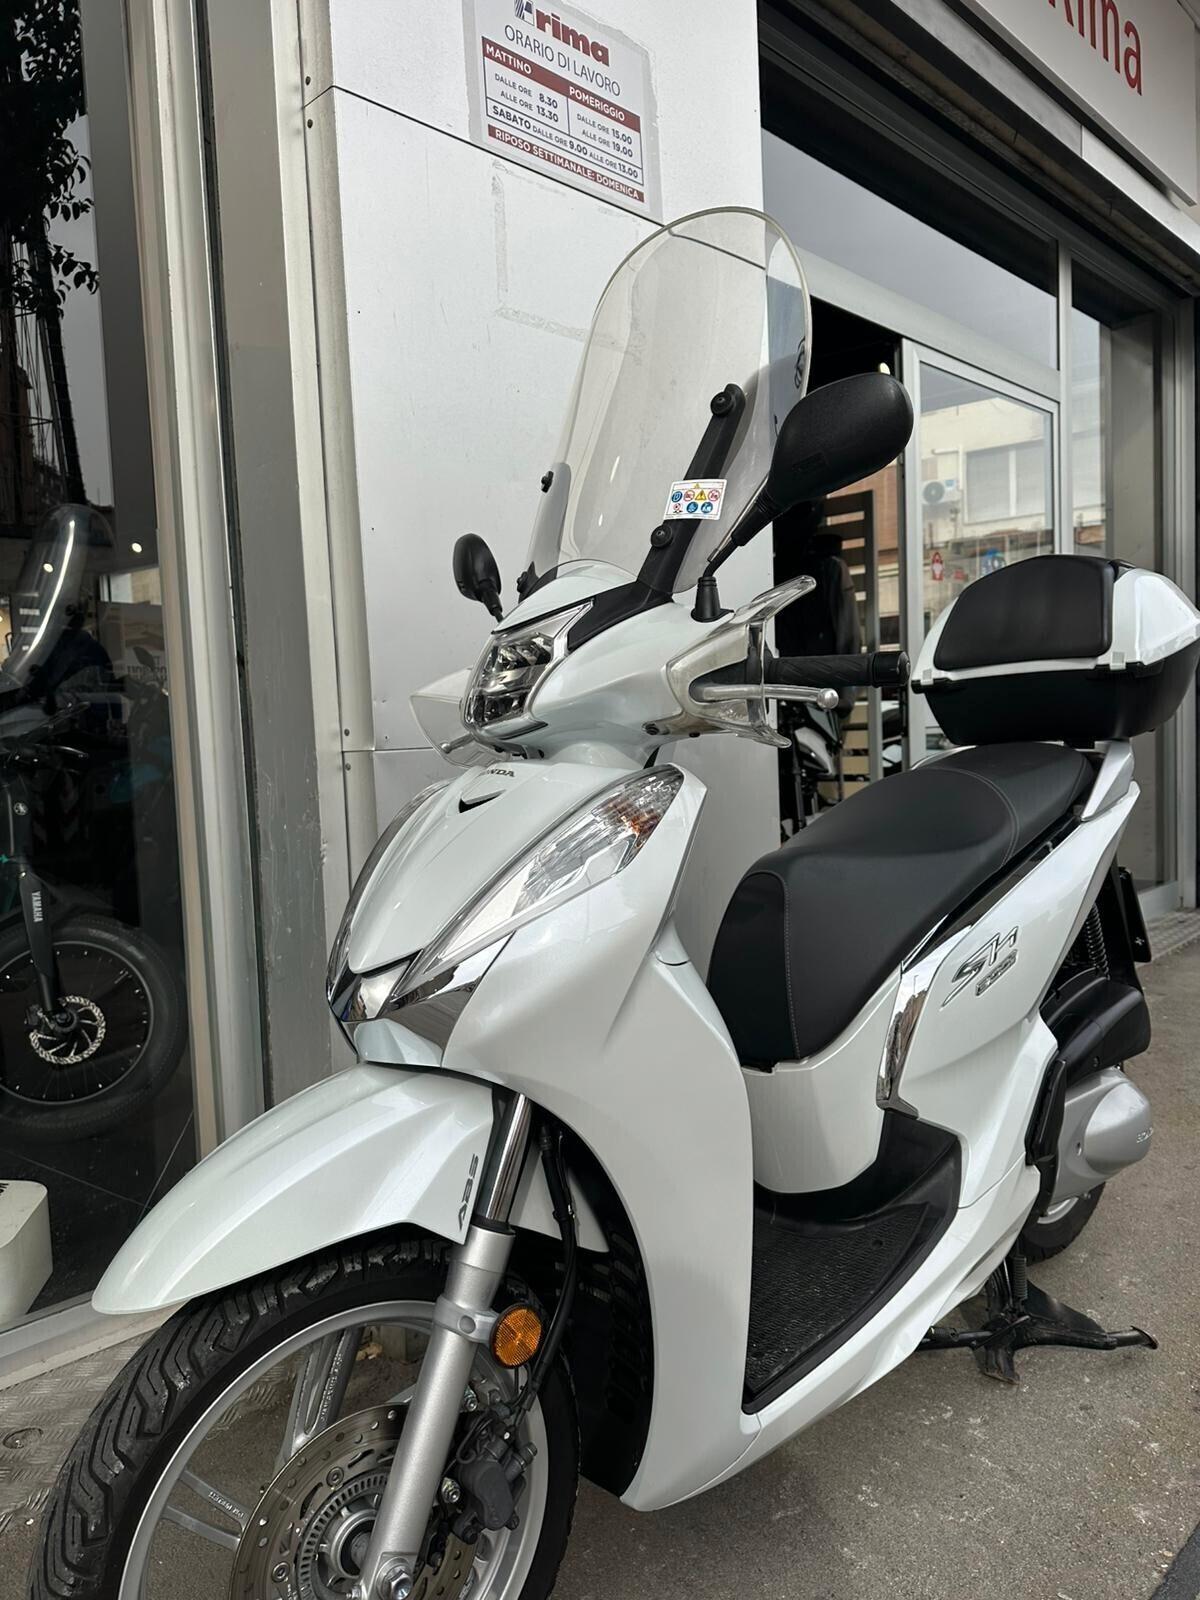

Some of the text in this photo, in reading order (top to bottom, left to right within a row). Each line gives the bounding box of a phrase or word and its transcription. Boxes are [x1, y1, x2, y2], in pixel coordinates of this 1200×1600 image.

[485, 43, 532, 75] MATTINO
[504, 24, 621, 97] ORARIO DI LAVORO
[494, 72, 558, 109] DALLE ORE 8.30
[500, 90, 559, 122] ALLE ORE 13.30
[568, 86, 625, 121] POMERIGGIO
[492, 105, 639, 179] SABATO DALLE ORE 9.00 ALLE ORE 13.00
[577, 113, 633, 145] DALLE ORE 15.00
[582, 129, 634, 158] ALLE ORE 19.00
[495, 128, 639, 200] RIPOSO SETTIMANALE: DOMENICA
[31, 890, 44, 923] YAMAHA
[457, 1153, 480, 1232] ABS
